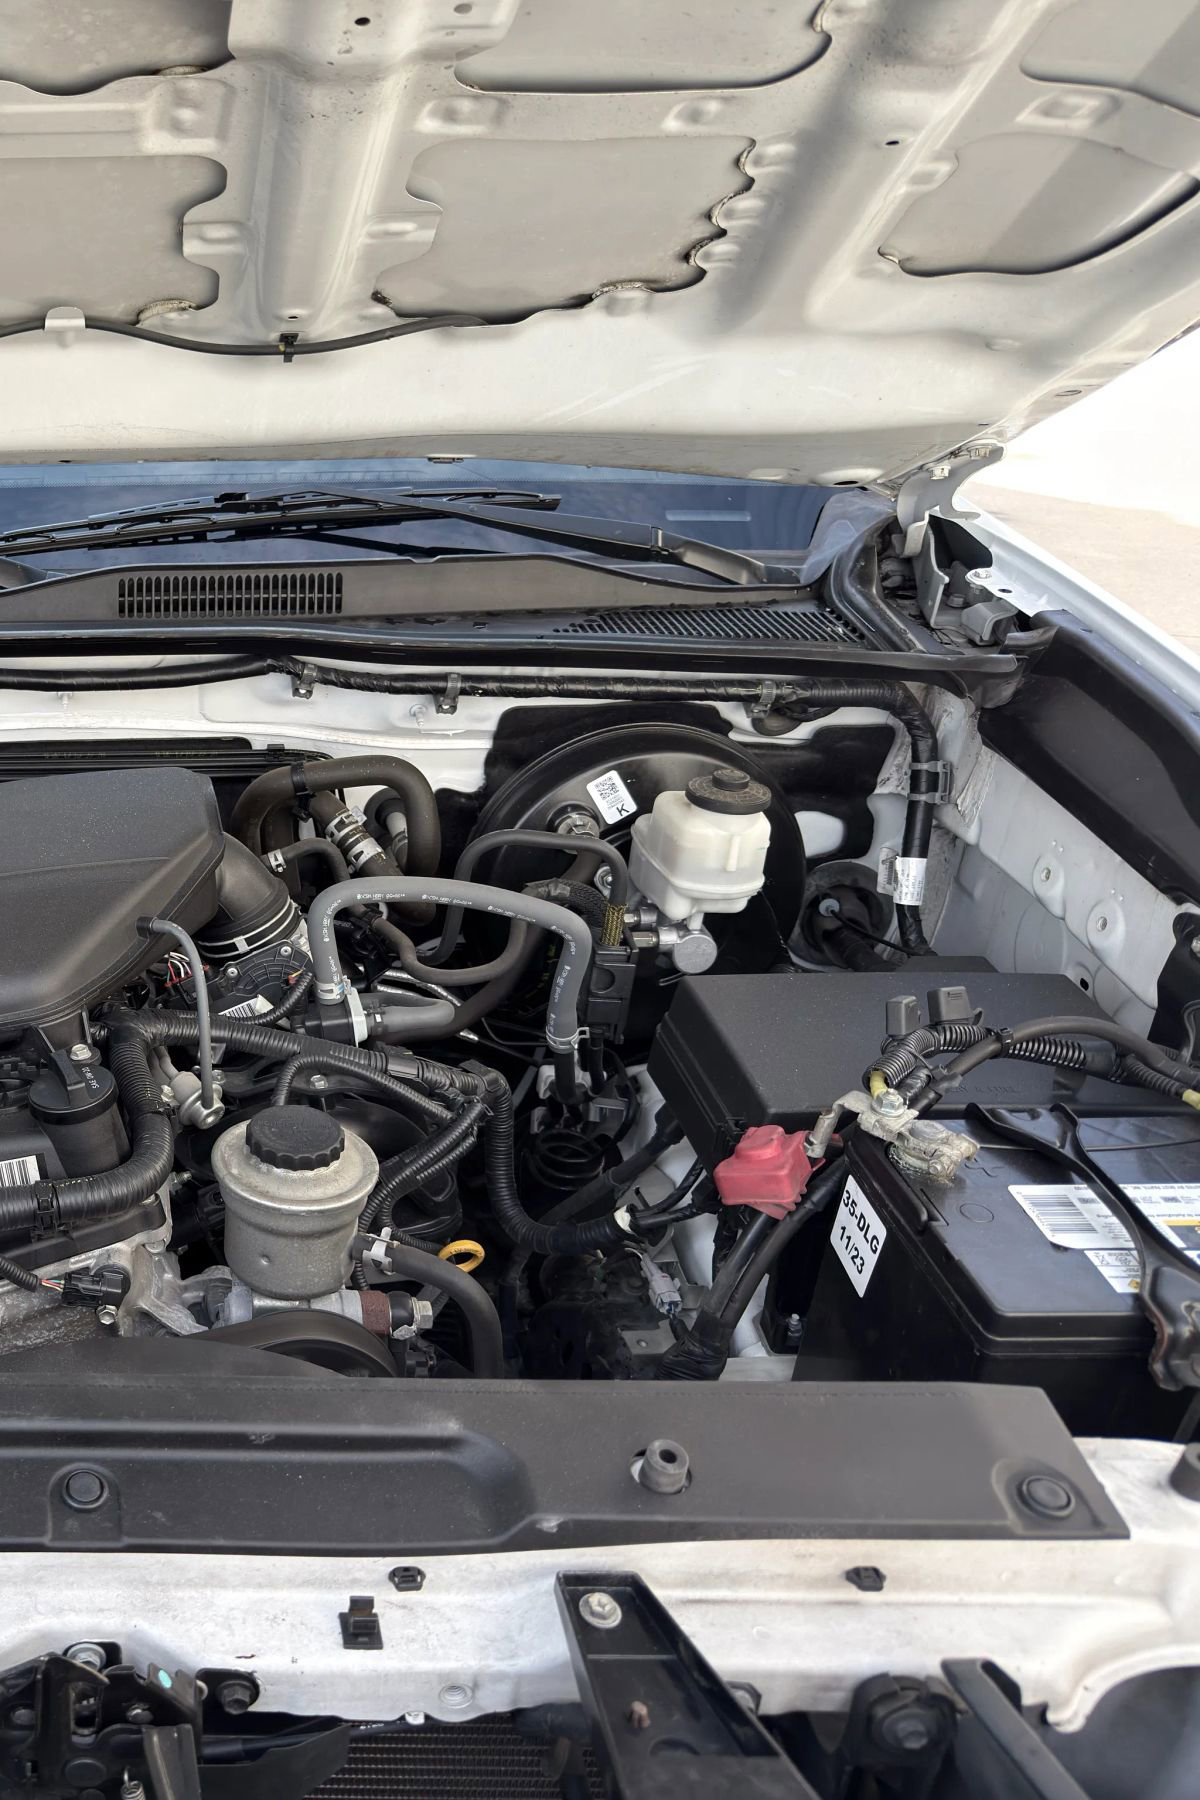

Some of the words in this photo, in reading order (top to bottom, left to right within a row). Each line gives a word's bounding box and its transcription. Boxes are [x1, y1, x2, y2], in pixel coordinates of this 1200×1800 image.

[616, 803, 630, 817] K
[842, 1189, 880, 1255] 35-DLG
[840, 1225, 865, 1275] 11/23
